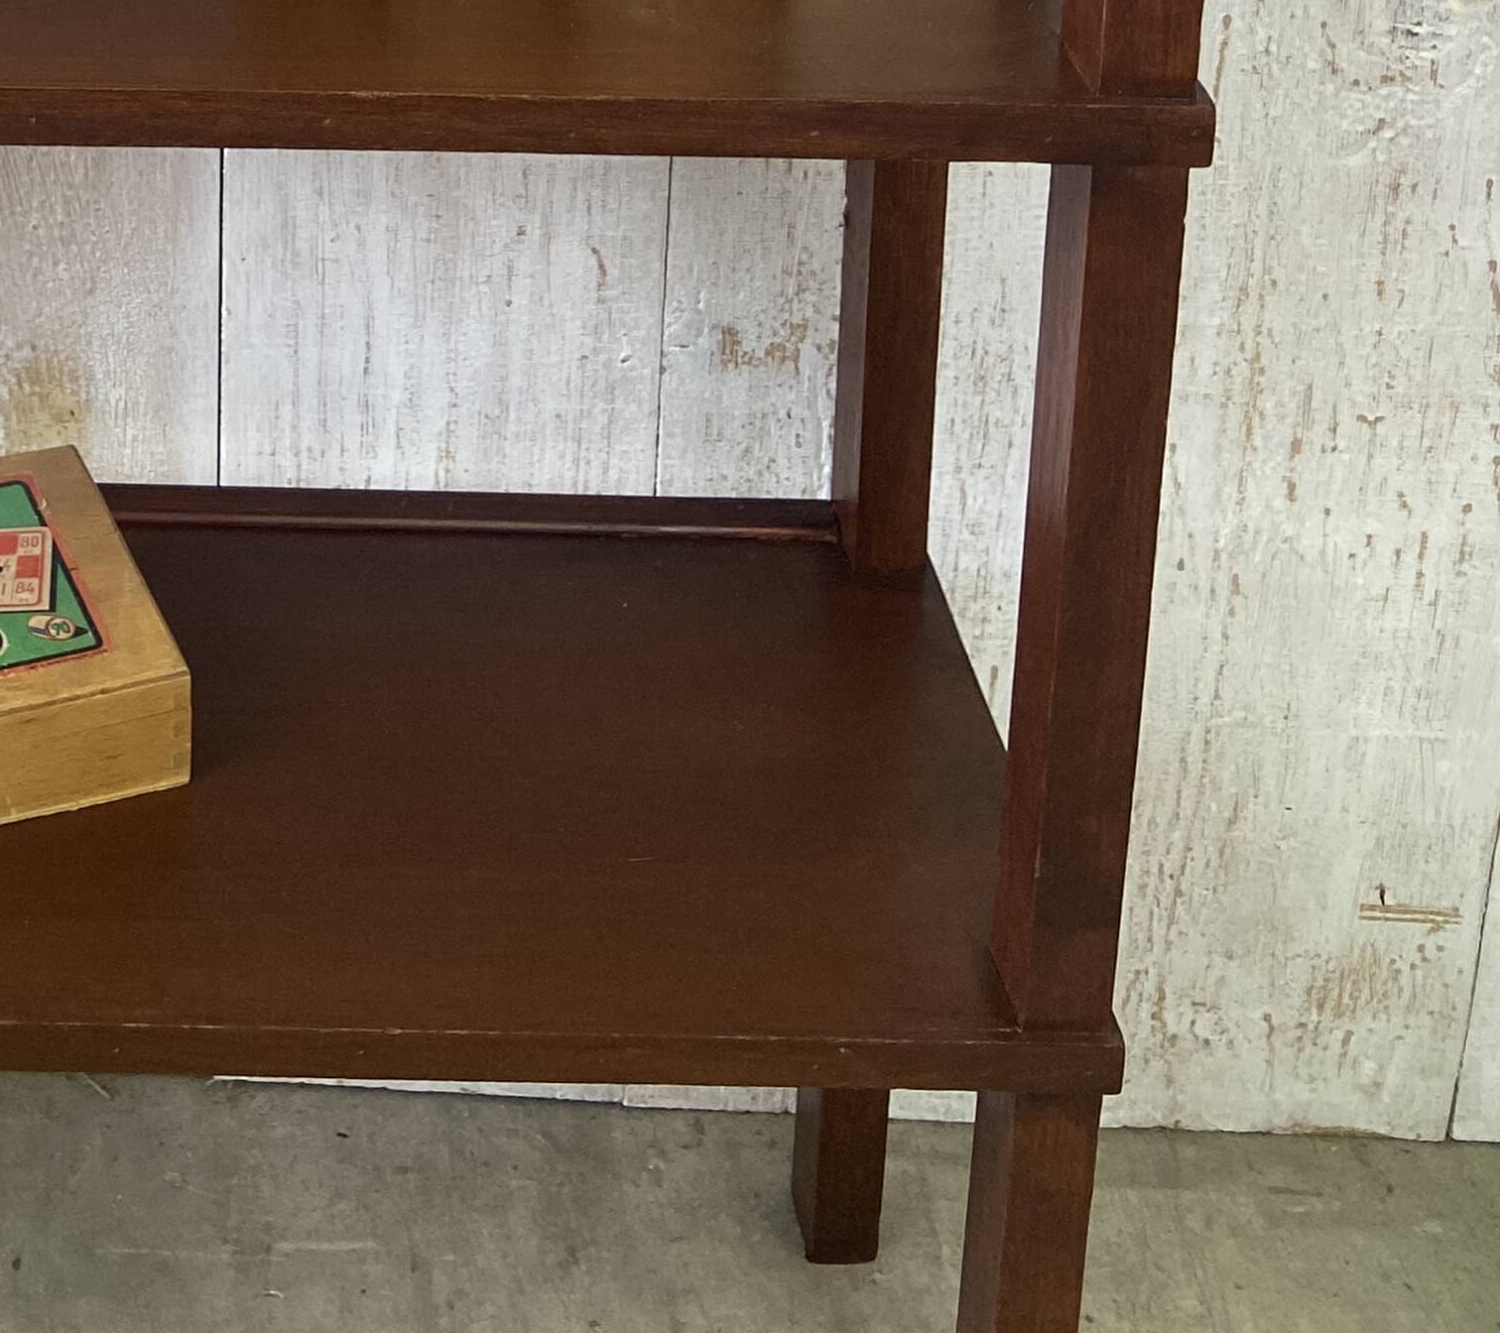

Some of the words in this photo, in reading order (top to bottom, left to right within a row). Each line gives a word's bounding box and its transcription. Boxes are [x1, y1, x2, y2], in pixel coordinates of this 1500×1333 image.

[20, 536, 39, 548] 80
[15, 582, 35, 594] 84
[51, 621, 71, 636] 90
